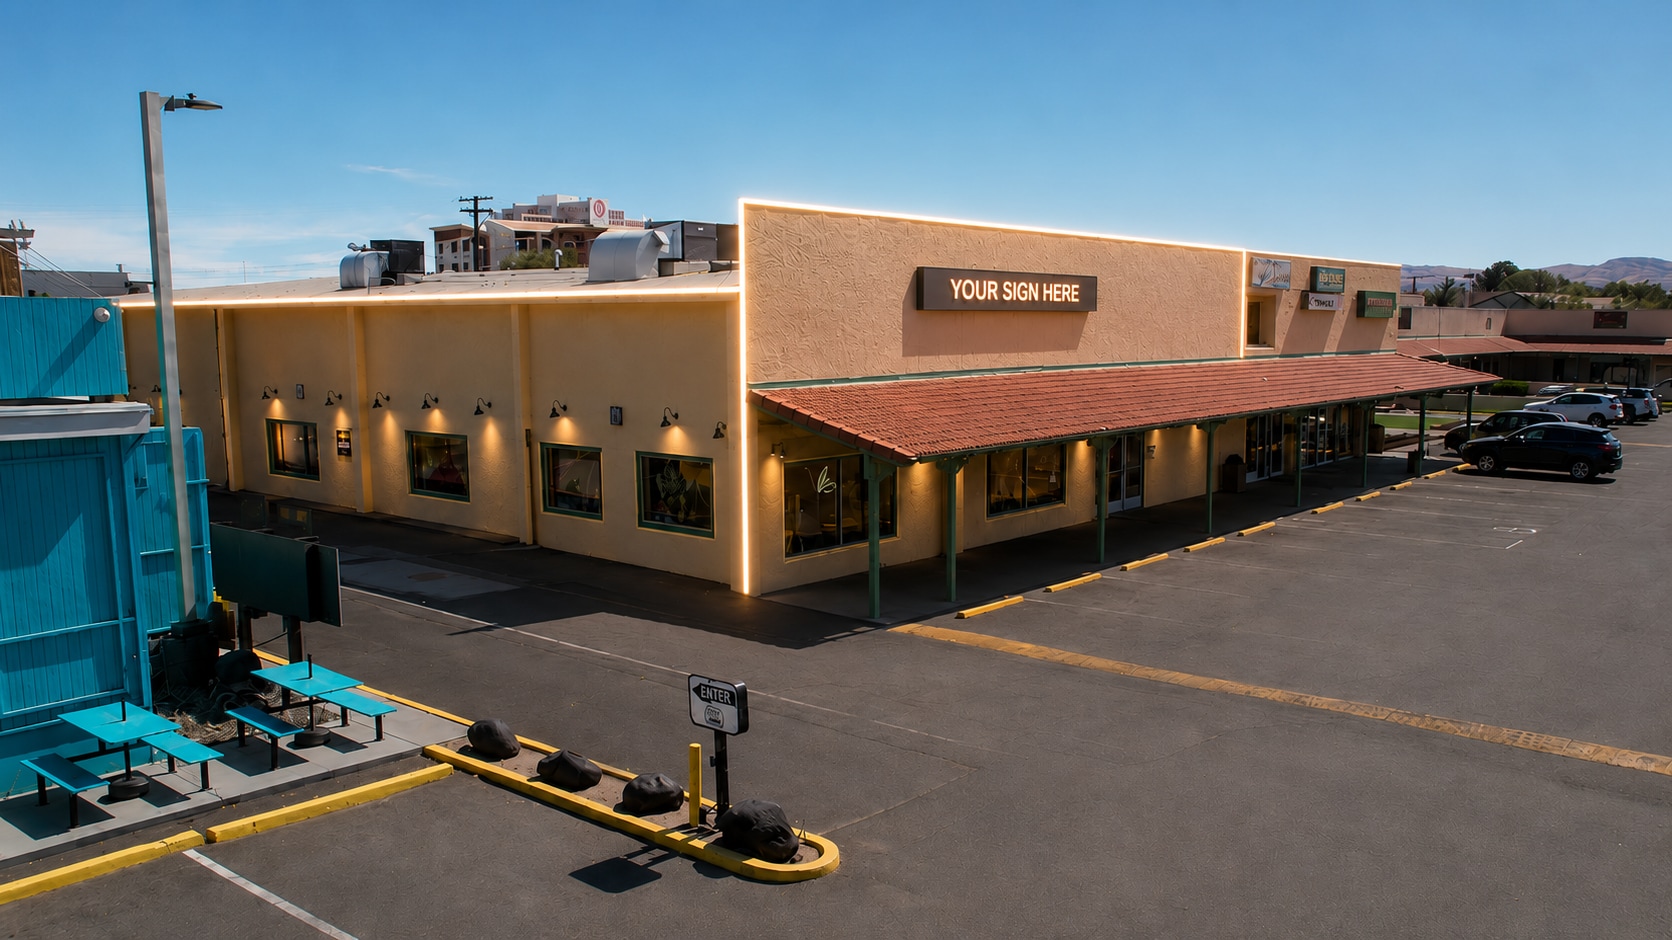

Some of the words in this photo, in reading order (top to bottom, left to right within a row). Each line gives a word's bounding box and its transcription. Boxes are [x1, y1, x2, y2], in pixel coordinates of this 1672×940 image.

[950, 279, 998, 300] YOUR
[1002, 281, 1039, 301] SIGN
[1043, 283, 1080, 302] HERE
[701, 685, 731, 704] ENTER
